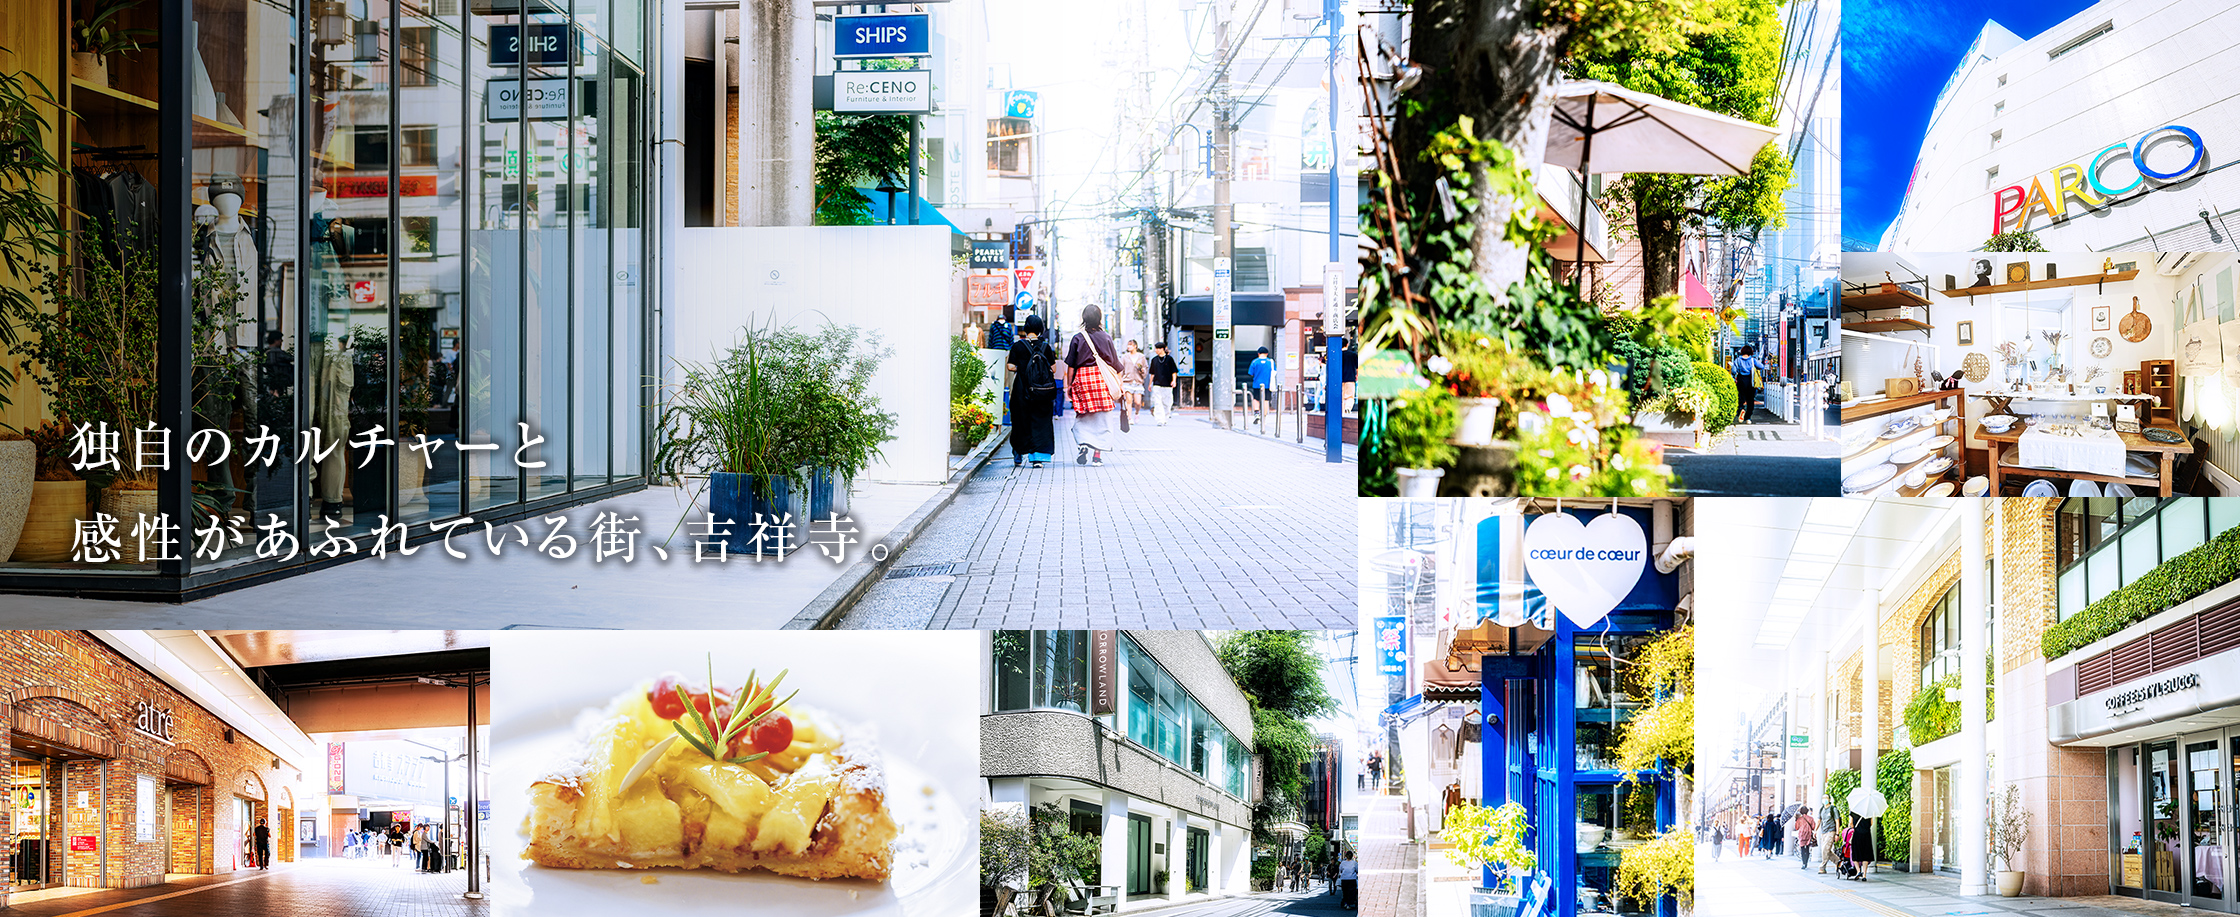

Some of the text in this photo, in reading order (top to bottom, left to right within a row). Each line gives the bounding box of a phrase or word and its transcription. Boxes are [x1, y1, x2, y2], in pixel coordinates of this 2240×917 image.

[855, 26, 907, 44] SHIPS
[846, 81, 917, 94] Re:CENO
[1992, 125, 2204, 237] PARCO
[974, 248, 1005, 256] PEARLY
[974, 255, 1005, 263] GATES
[971, 279, 1008, 300] フルギ
[1575, 547, 1595, 560] de
[1098, 630, 1108, 706] ORROWLAND
[2105, 688, 2138, 709] COFFEE
[138, 698, 174, 741] atré
